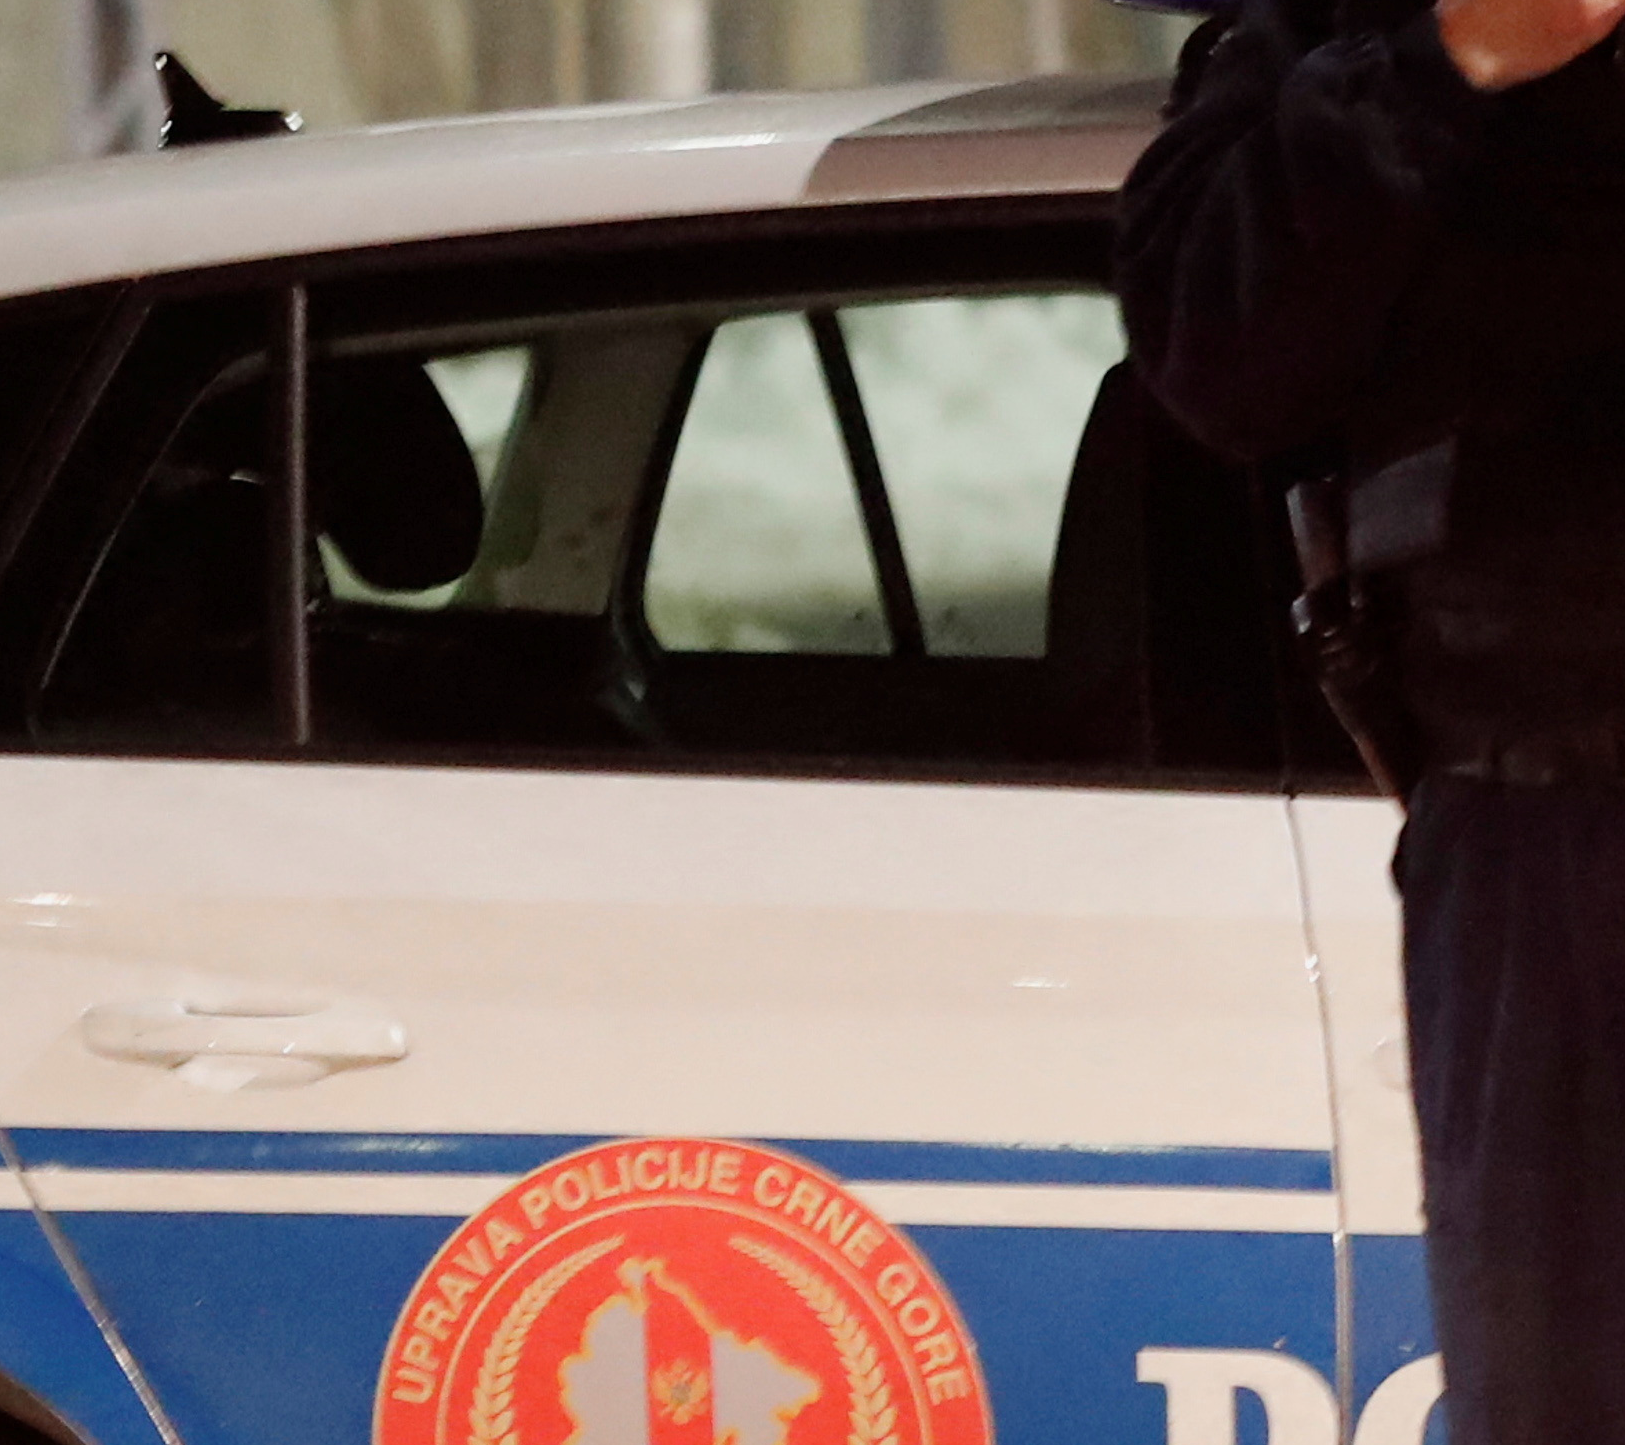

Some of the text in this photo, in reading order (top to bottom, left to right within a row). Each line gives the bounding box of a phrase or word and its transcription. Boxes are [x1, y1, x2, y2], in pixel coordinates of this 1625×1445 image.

[391, 1147, 971, 1409] UPRAVA POLICIJE CRNE GORE
